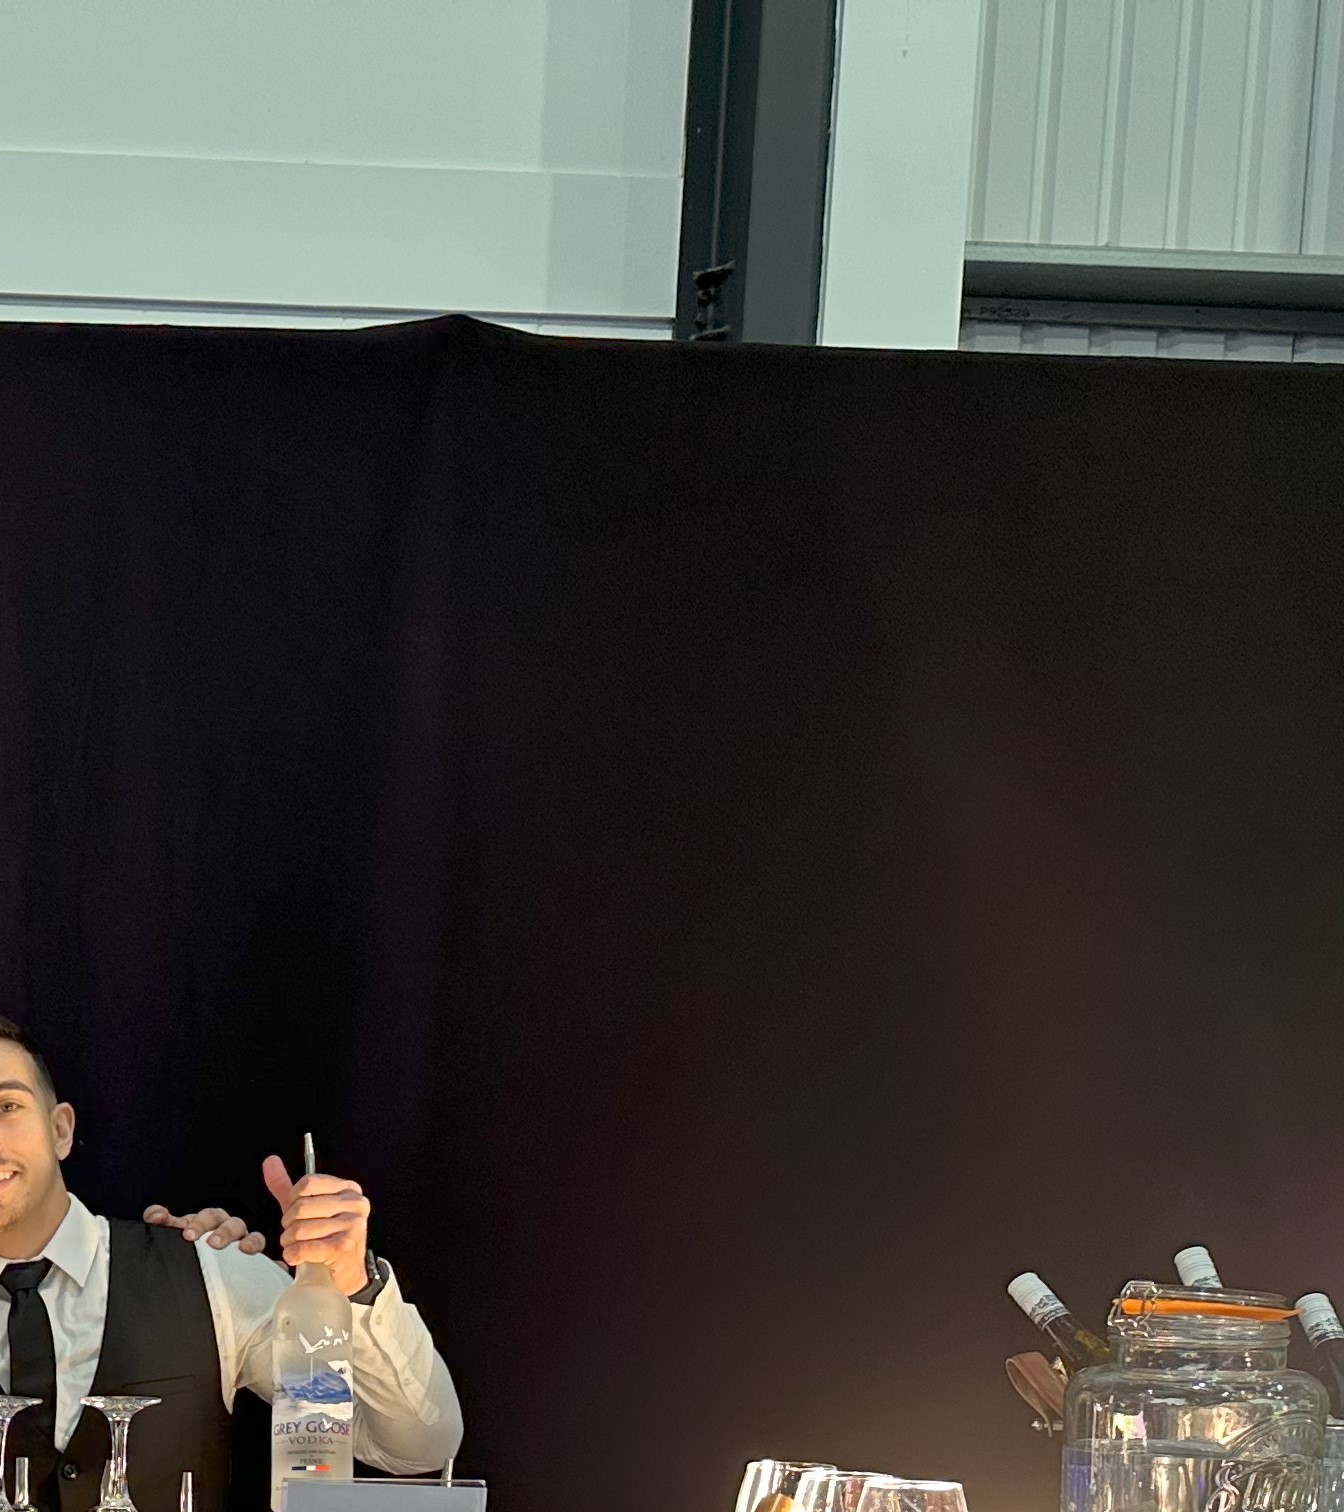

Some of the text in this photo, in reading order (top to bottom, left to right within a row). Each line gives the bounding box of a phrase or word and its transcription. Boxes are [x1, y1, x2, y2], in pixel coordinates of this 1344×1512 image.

[274, 1420, 350, 1436] GREY GOOSE
[289, 1436, 334, 1445] VODKA
